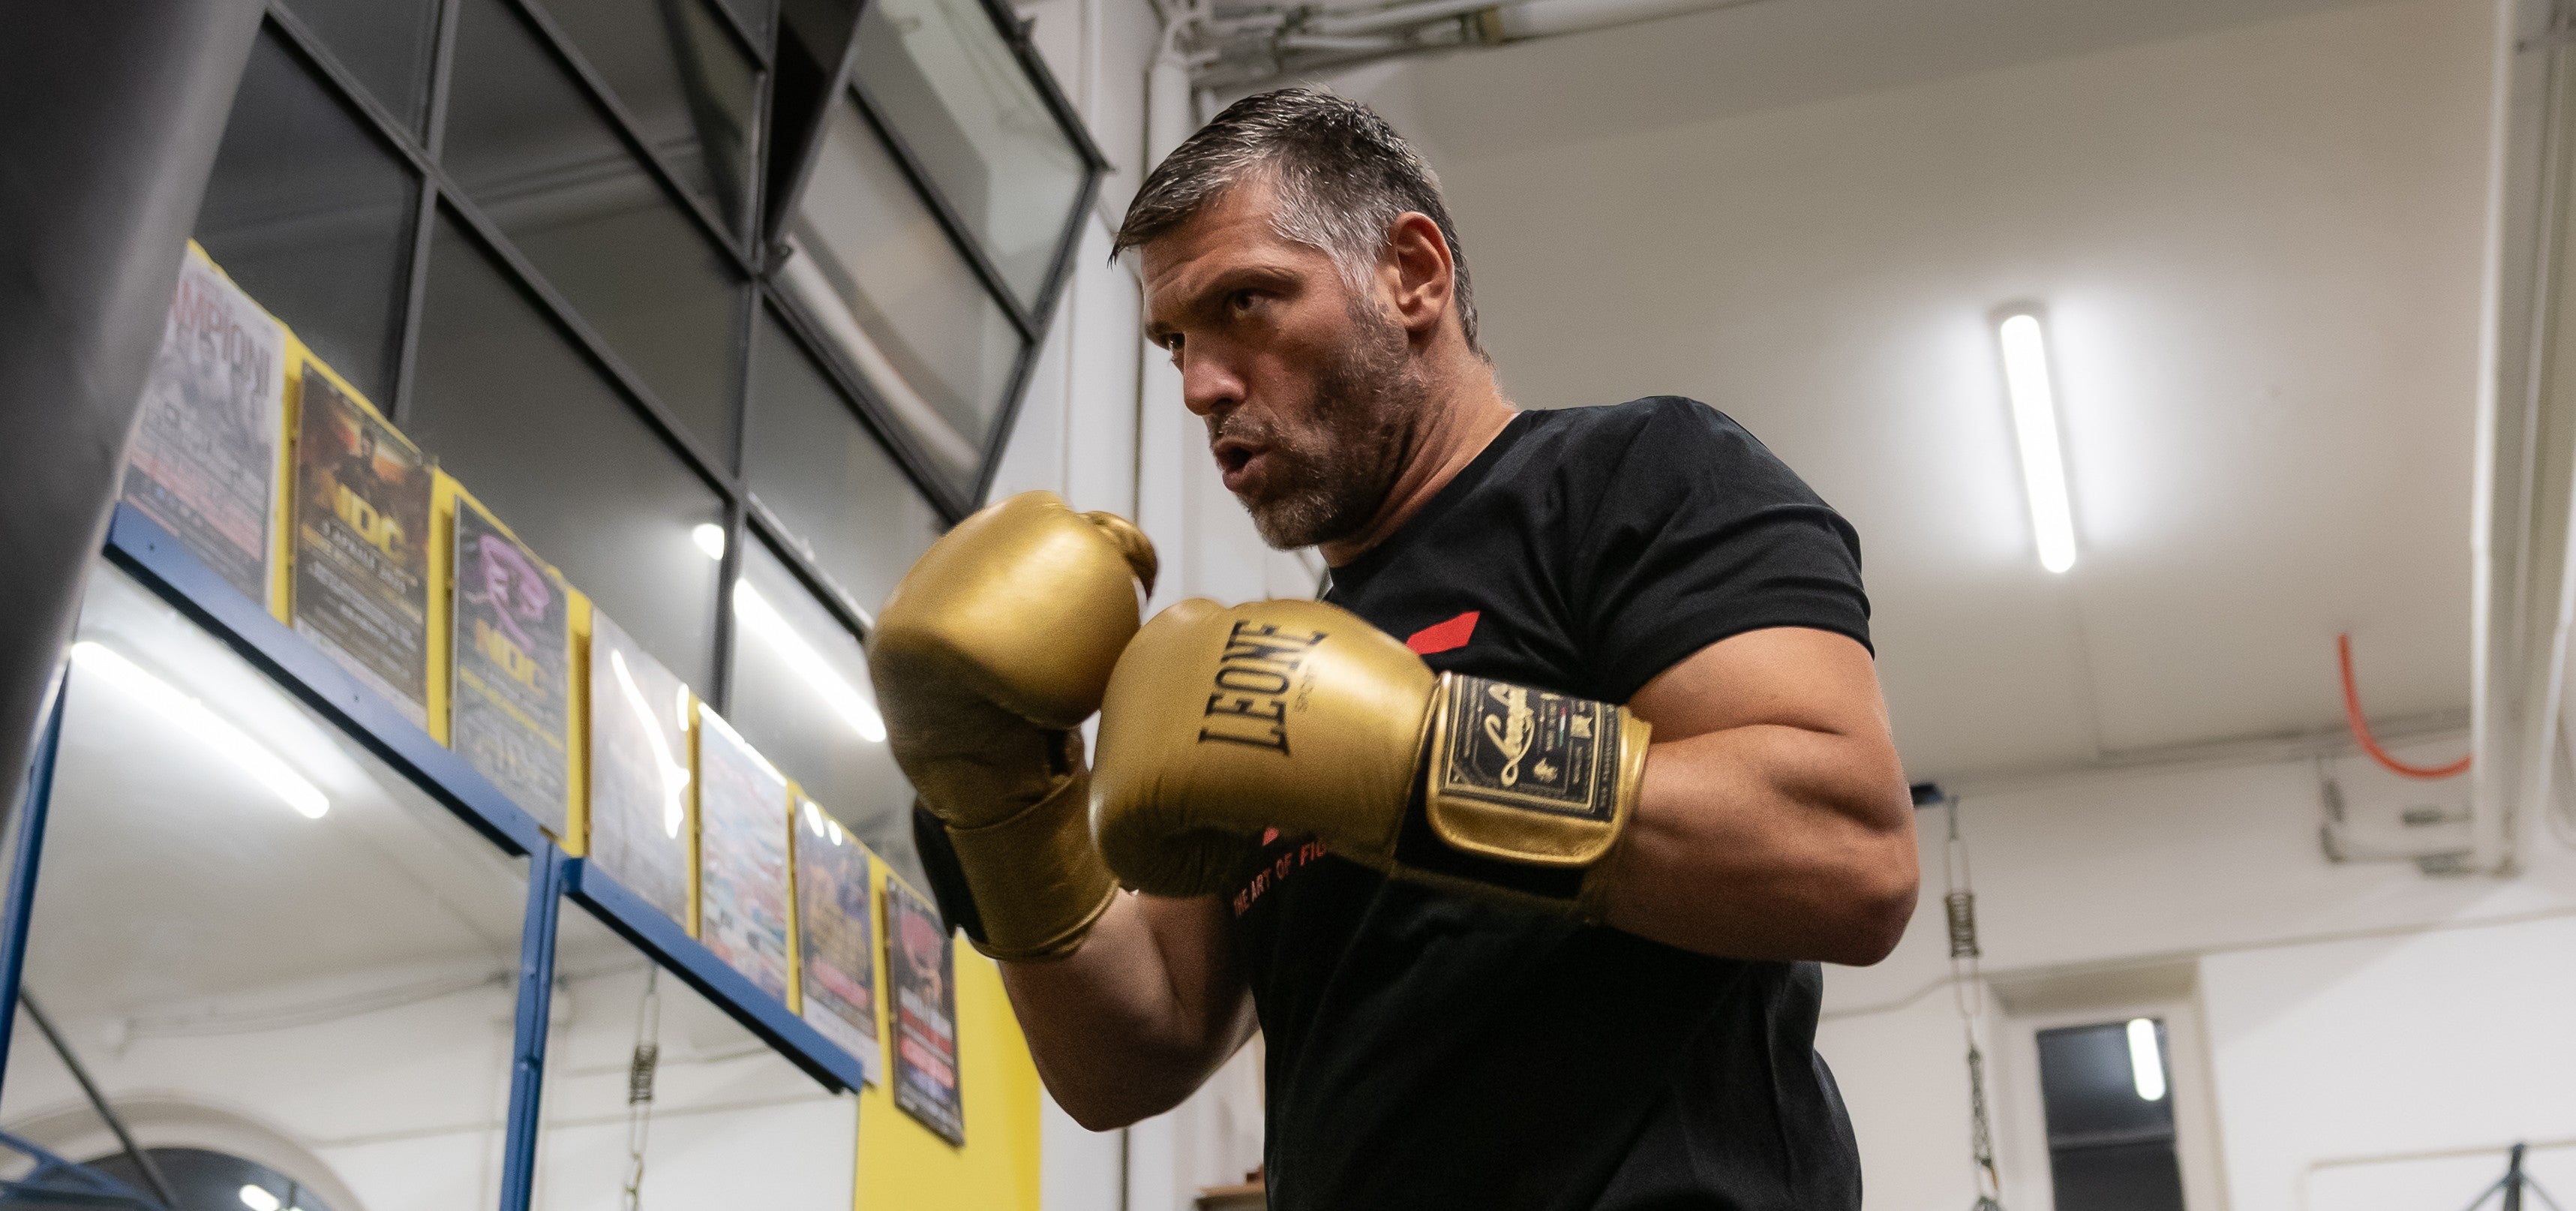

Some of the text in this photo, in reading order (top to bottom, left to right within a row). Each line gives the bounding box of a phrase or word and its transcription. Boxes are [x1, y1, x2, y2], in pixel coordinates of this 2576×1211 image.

[1198, 617, 1329, 757] LEONE
[1250, 867, 1272, 903] ART
[1276, 852, 1293, 881] OF
